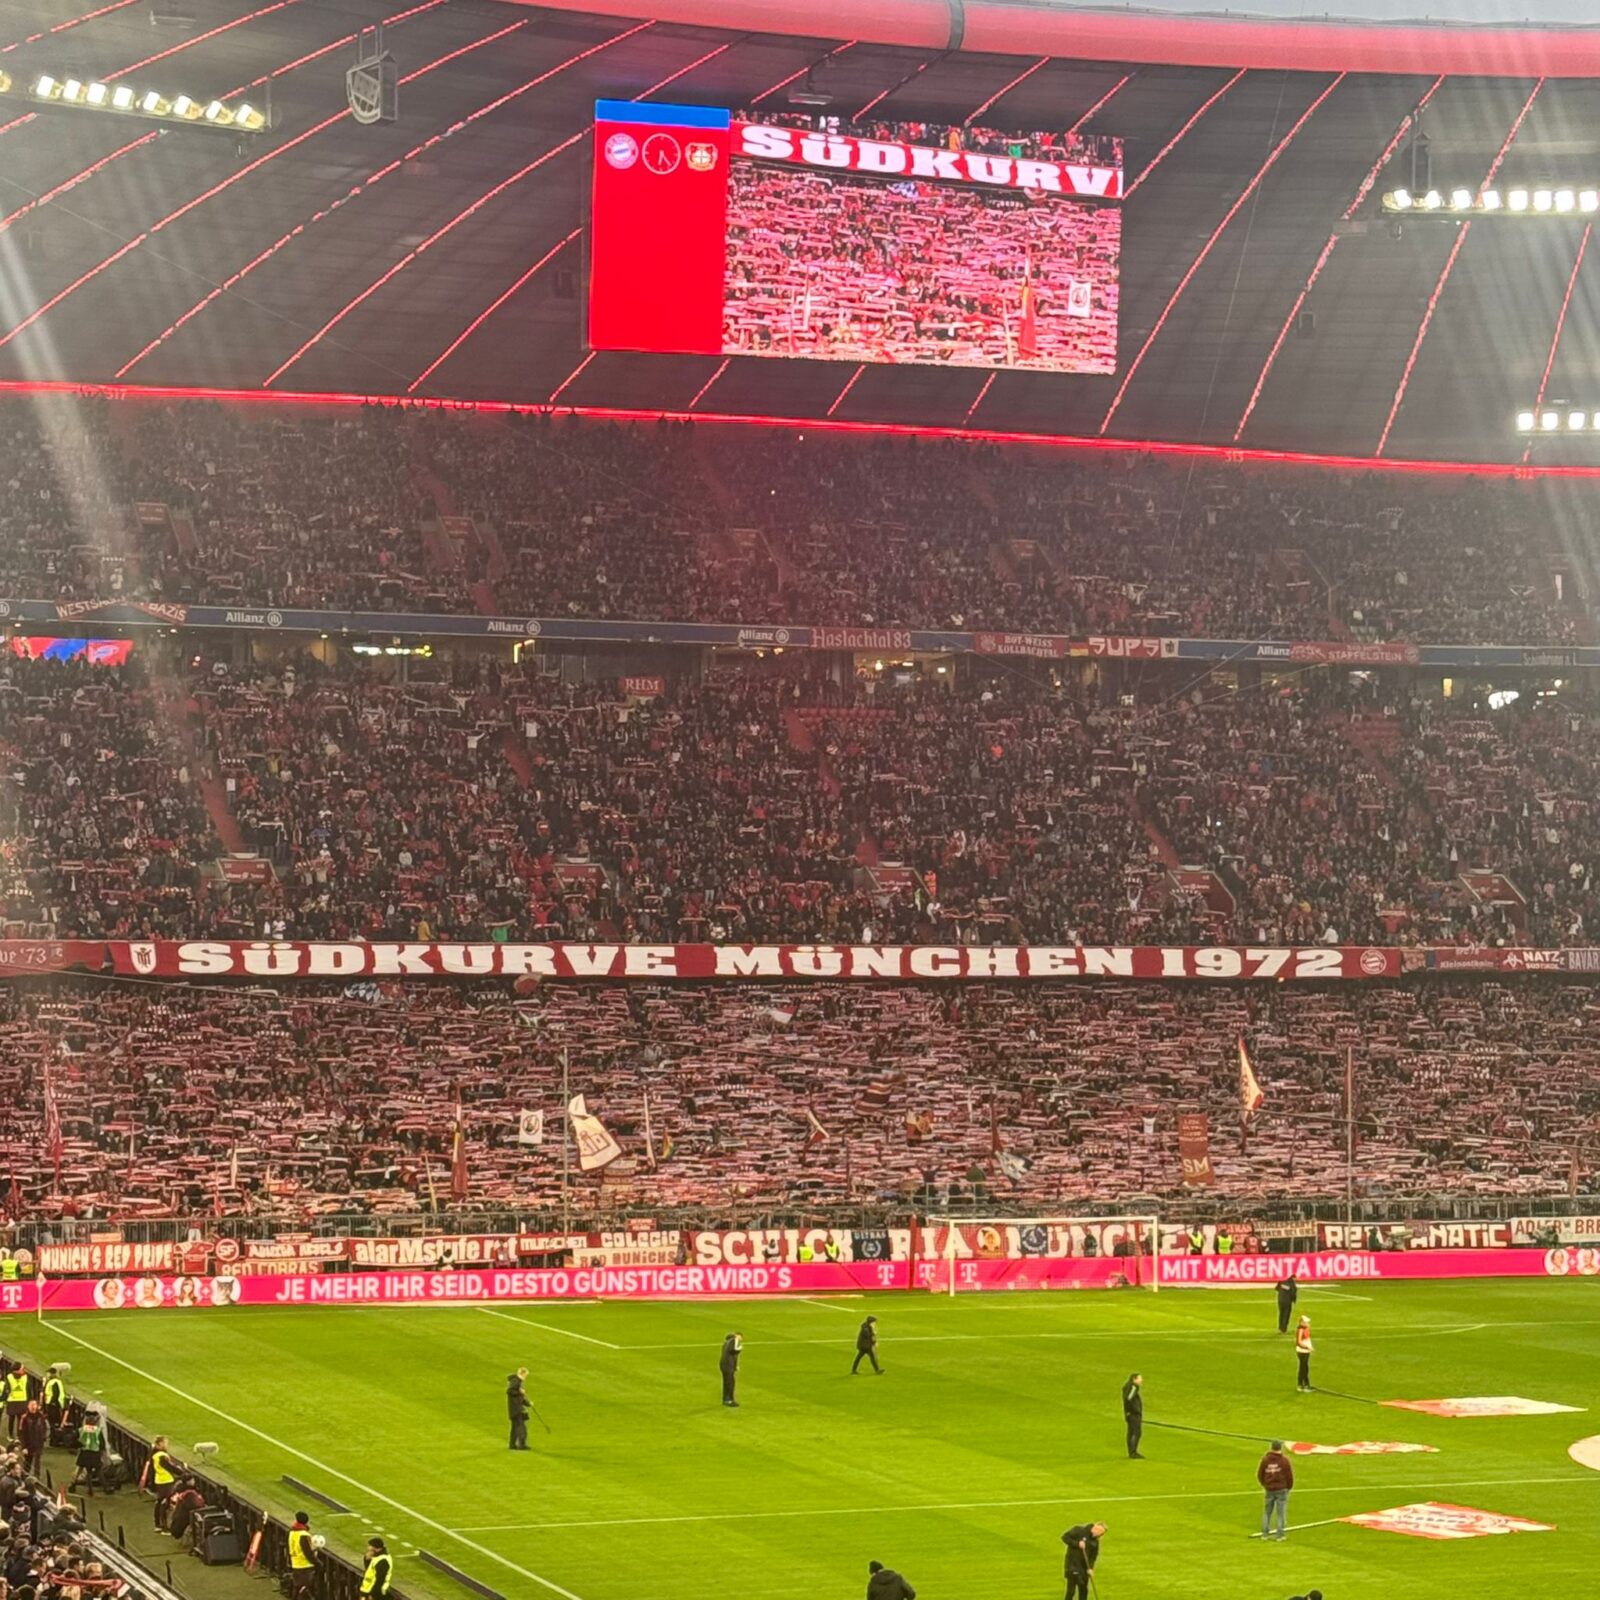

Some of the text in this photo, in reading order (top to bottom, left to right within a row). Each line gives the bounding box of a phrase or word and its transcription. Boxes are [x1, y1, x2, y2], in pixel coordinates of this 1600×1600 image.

[741, 124, 1123, 198] SÜDKURV
[225, 611, 264, 624] Allianz
[487, 620, 525, 633] Allianz
[738, 628, 774, 642] Allianz
[893, 631, 911, 648] 83
[1256, 645, 1290, 656] Allianz
[625, 677, 660, 691] RHM
[178, 941, 678, 976] SÜDKURVE
[714, 946, 1134, 976] MÜNCHEN
[1161, 948, 1342, 977] 1972
[1522, 951, 1559, 963] NATZ
[1162, 1254, 1380, 1280] MIT MAGENTA MOBIL
[276, 1278, 307, 1301] JE
[311, 1276, 379, 1299] MEHR
[385, 1275, 425, 1298] IHR
[430, 1274, 488, 1299] SEID,
[494, 1273, 569, 1295] DESTO
[574, 1266, 703, 1292] GÜNSTIGER
